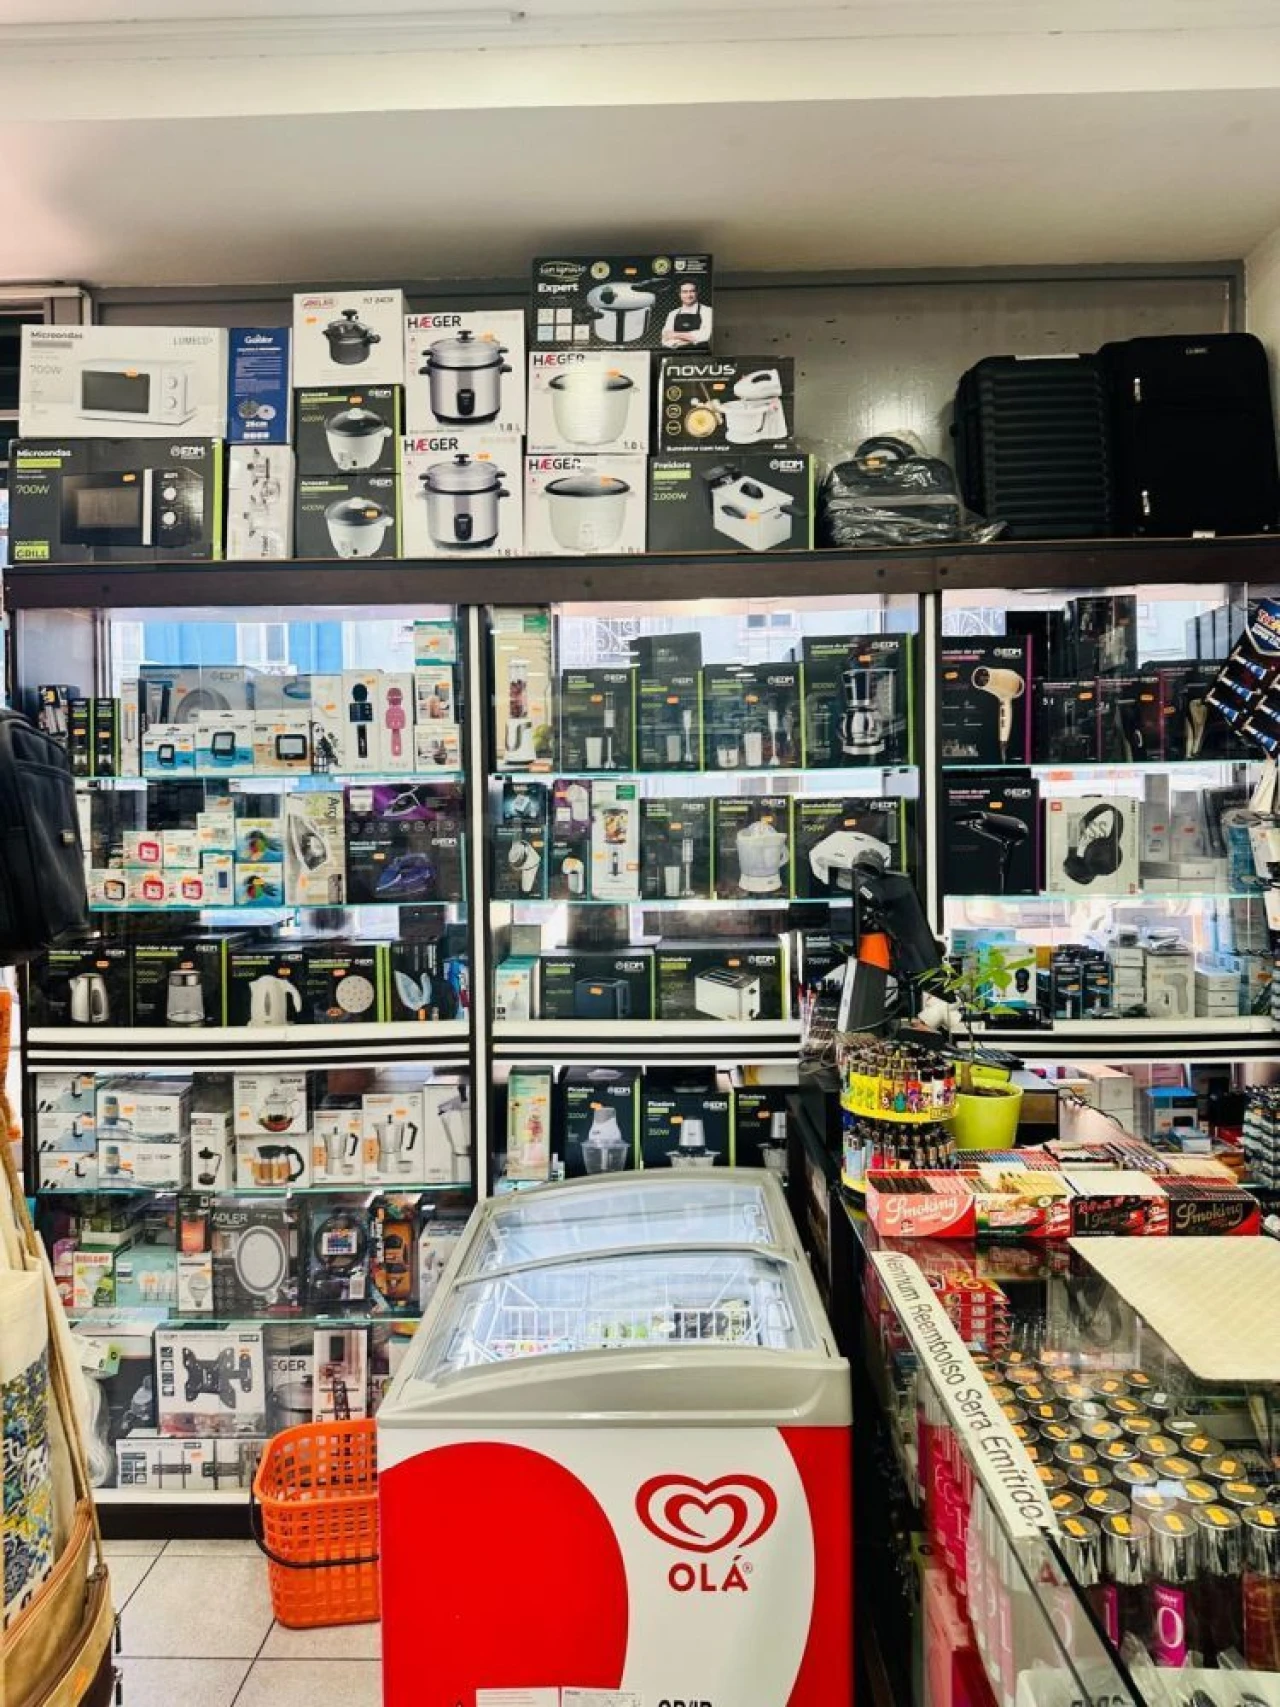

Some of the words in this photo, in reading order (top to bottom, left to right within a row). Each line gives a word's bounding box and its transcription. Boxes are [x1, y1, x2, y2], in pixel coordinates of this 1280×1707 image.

[537, 282, 579, 294] Expert
[407, 315, 462, 329] HÆGER
[30, 331, 83, 340] Microondas
[667, 363, 736, 377] novus
[403, 437, 459, 452] HÆGER
[16, 448, 72, 457] Microondas
[16, 484, 50, 495] 700W
[885, 1194, 957, 1224] Smoking
[1175, 1202, 1243, 1229] Smoking
[212, 1212, 248, 1223] ADLER
[909, 1303, 966, 1386] Reembolso
[981, 1436, 1043, 1526] Emitido.
[668, 1554, 749, 1592] OLÁ
